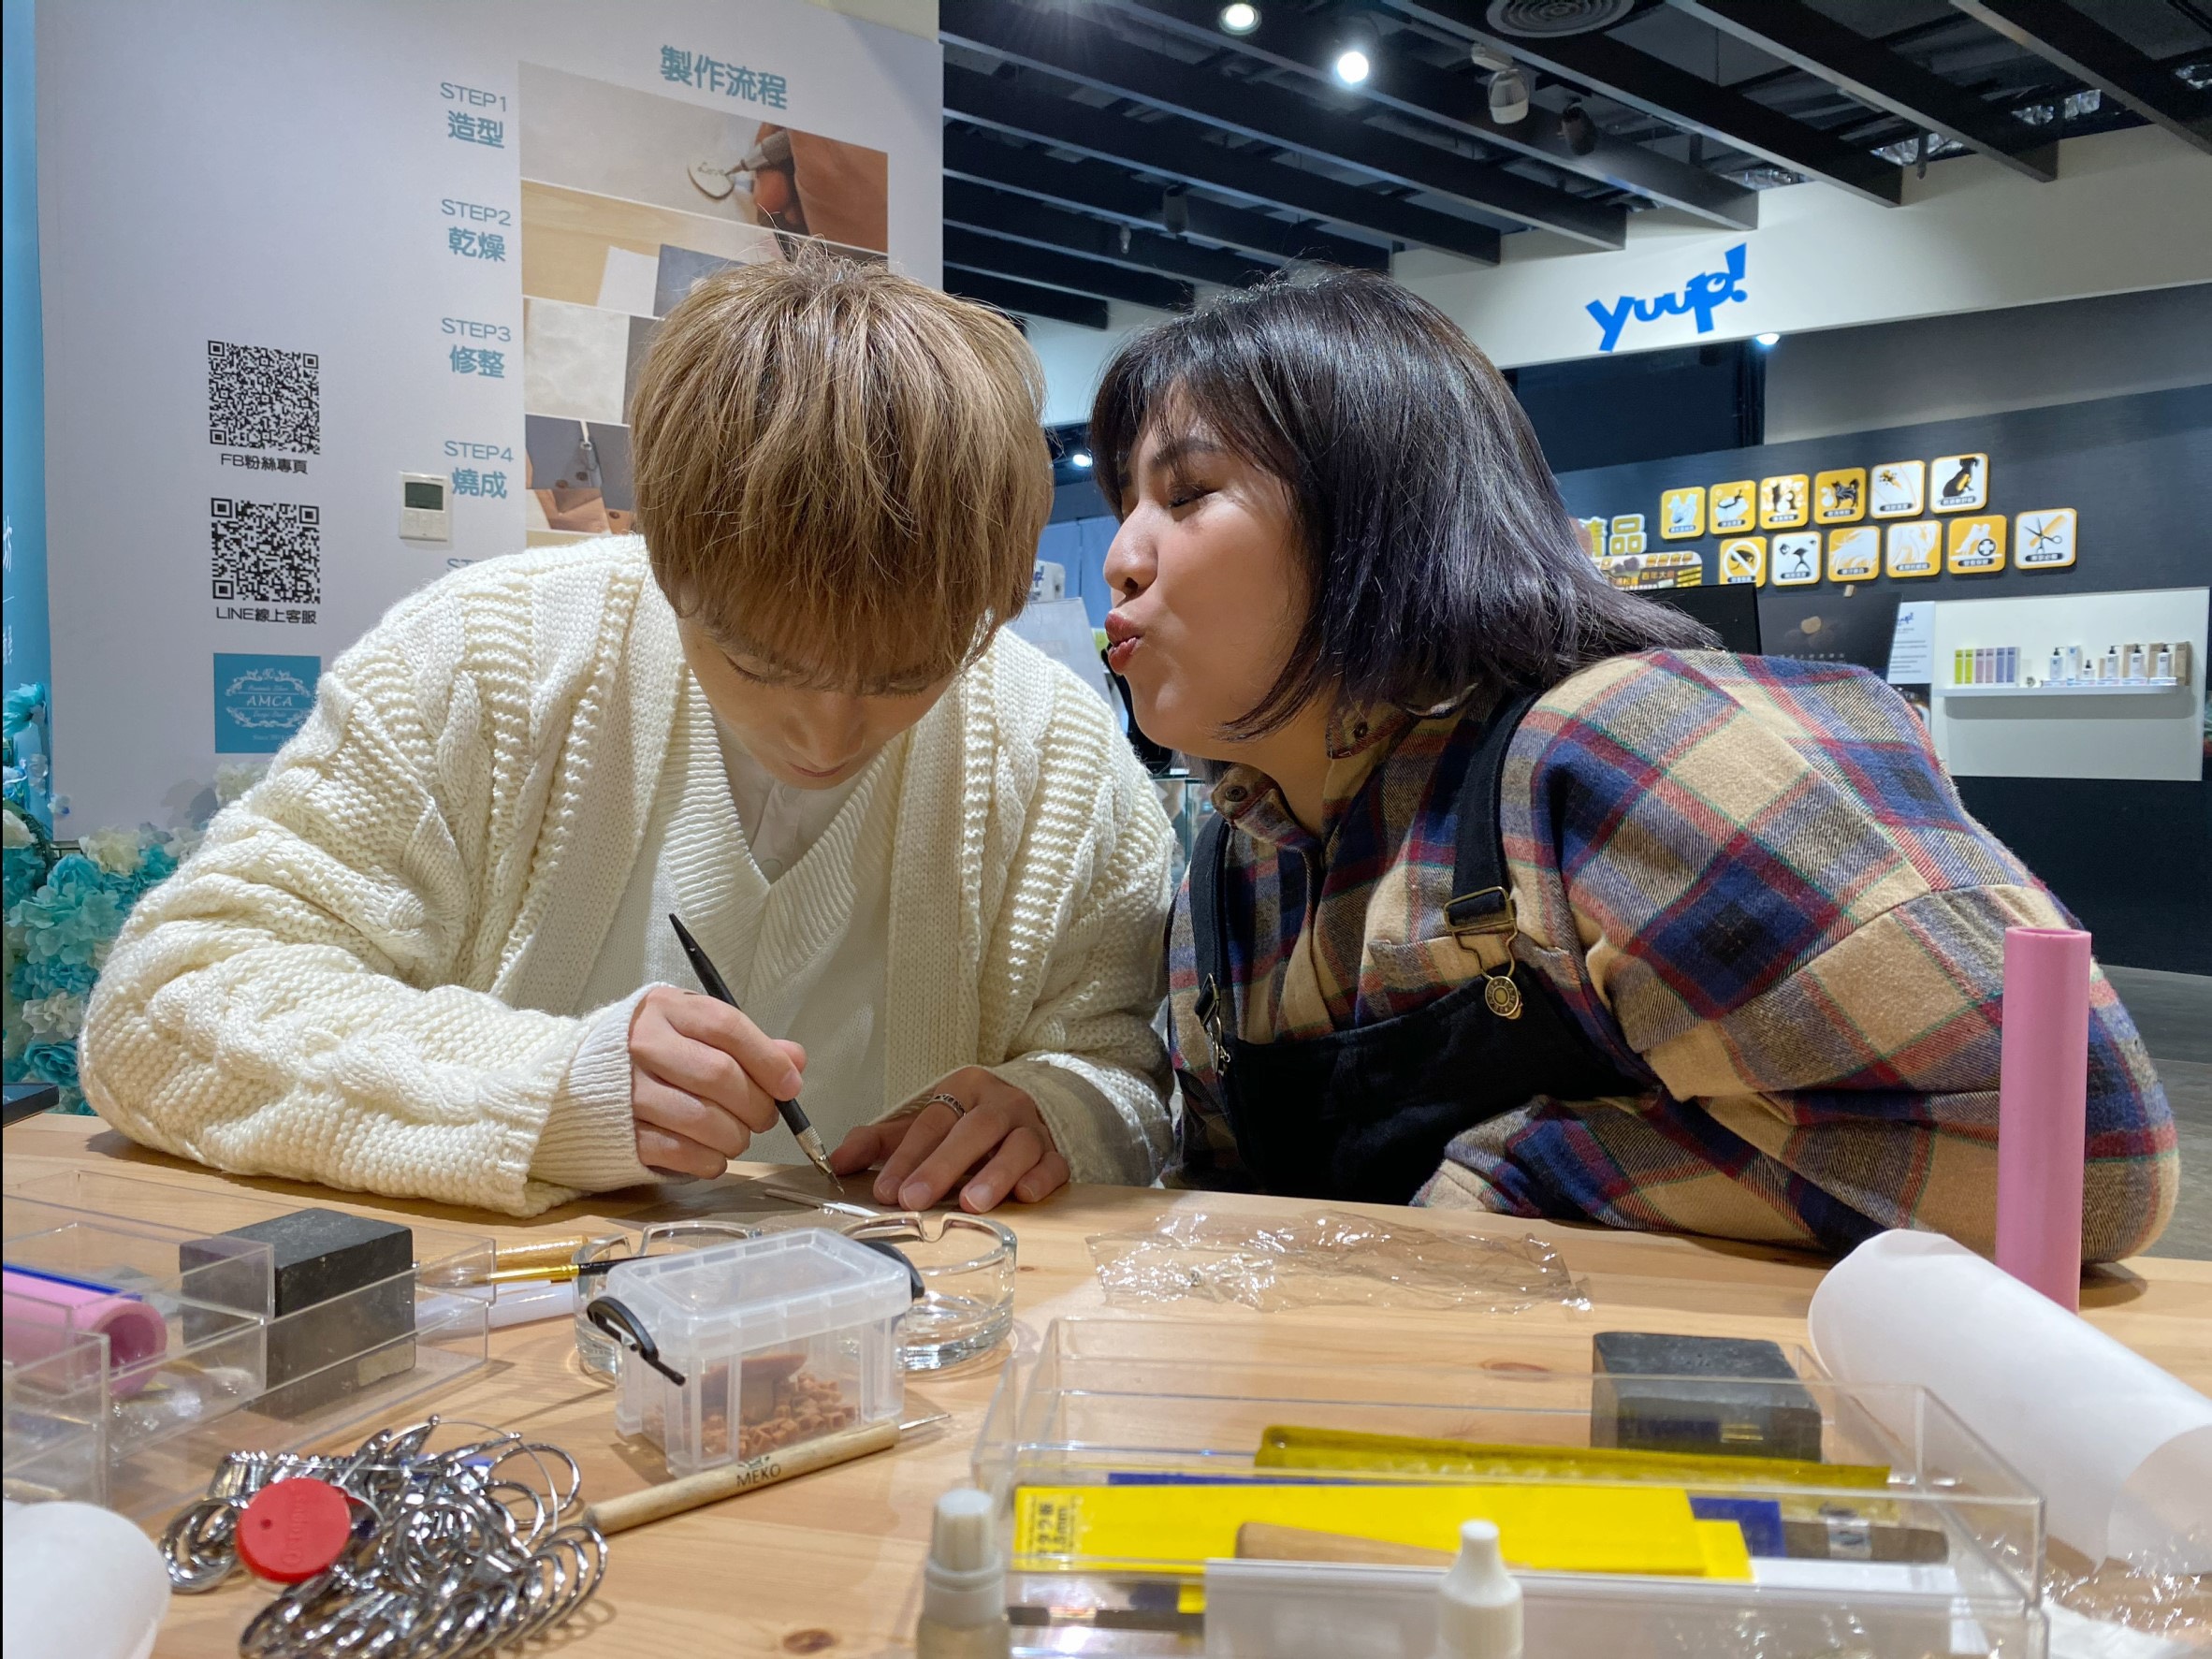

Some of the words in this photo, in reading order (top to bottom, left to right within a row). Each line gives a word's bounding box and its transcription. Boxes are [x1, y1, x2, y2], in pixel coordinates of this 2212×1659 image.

[661, 45, 787, 109] 製作流程
[440, 82, 506, 112] STEP1
[448, 110, 504, 149] 造型
[442, 198, 512, 226] STEP2
[448, 226, 506, 262] 乾燥
[1585, 242, 1748, 353] yuup!
[442, 317, 511, 342] STEP3
[449, 344, 504, 378] 修整
[221, 453, 308, 475] FB粉絲專頁
[444, 441, 514, 462] STEP4
[452, 468, 507, 499] 燒成
[216, 606, 317, 624] LINE線上客服
[246, 694, 292, 707] AMCA
[736, 1463, 781, 1487] MEKO
